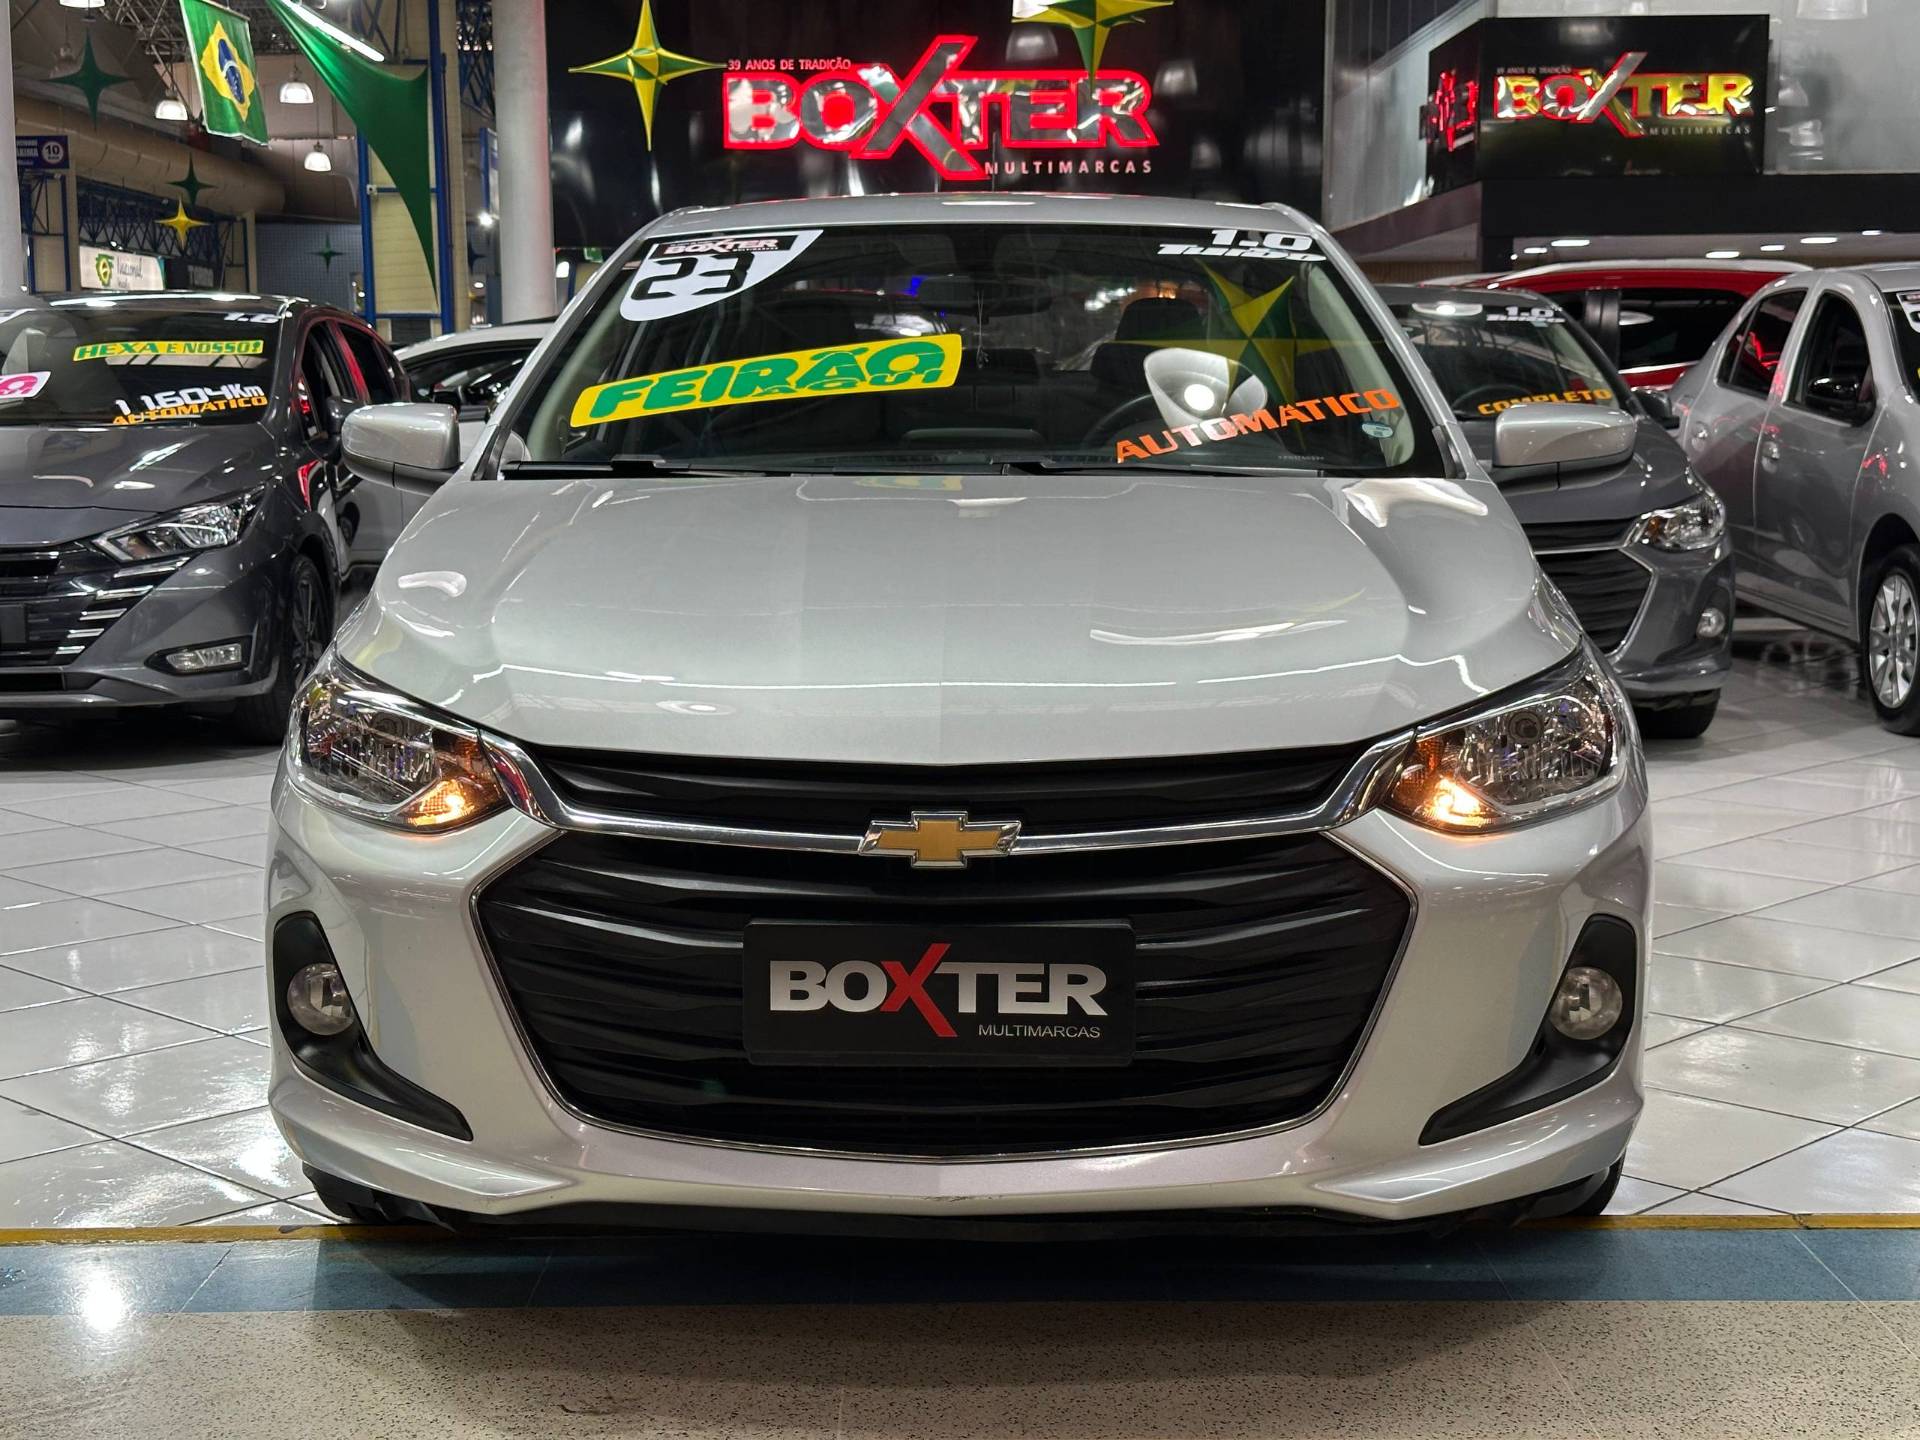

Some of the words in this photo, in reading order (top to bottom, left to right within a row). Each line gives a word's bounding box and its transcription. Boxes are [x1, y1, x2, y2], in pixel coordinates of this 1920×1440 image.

[727, 59, 741, 71] 39
[745, 59, 776, 71] ANOS
[780, 59, 795, 71] DE
[798, 57, 852, 72] TRADIÇÃO
[1494, 51, 1755, 138] BOXTER
[723, 35, 1160, 181] BOXTER
[1649, 124, 1752, 136] MULTIMARCAS
[984, 160, 1153, 174] MULTIMARCAS
[663, 238, 779, 255] BOXTER
[1211, 229, 1313, 251] 1.0
[630, 252, 755, 301] 23
[77, 342, 159, 359] HEXA
[589, 340, 946, 419] FEIRÃO
[769, 943, 1109, 1038] BOXTER
[978, 1024, 1101, 1038] MULTIMARCAS
